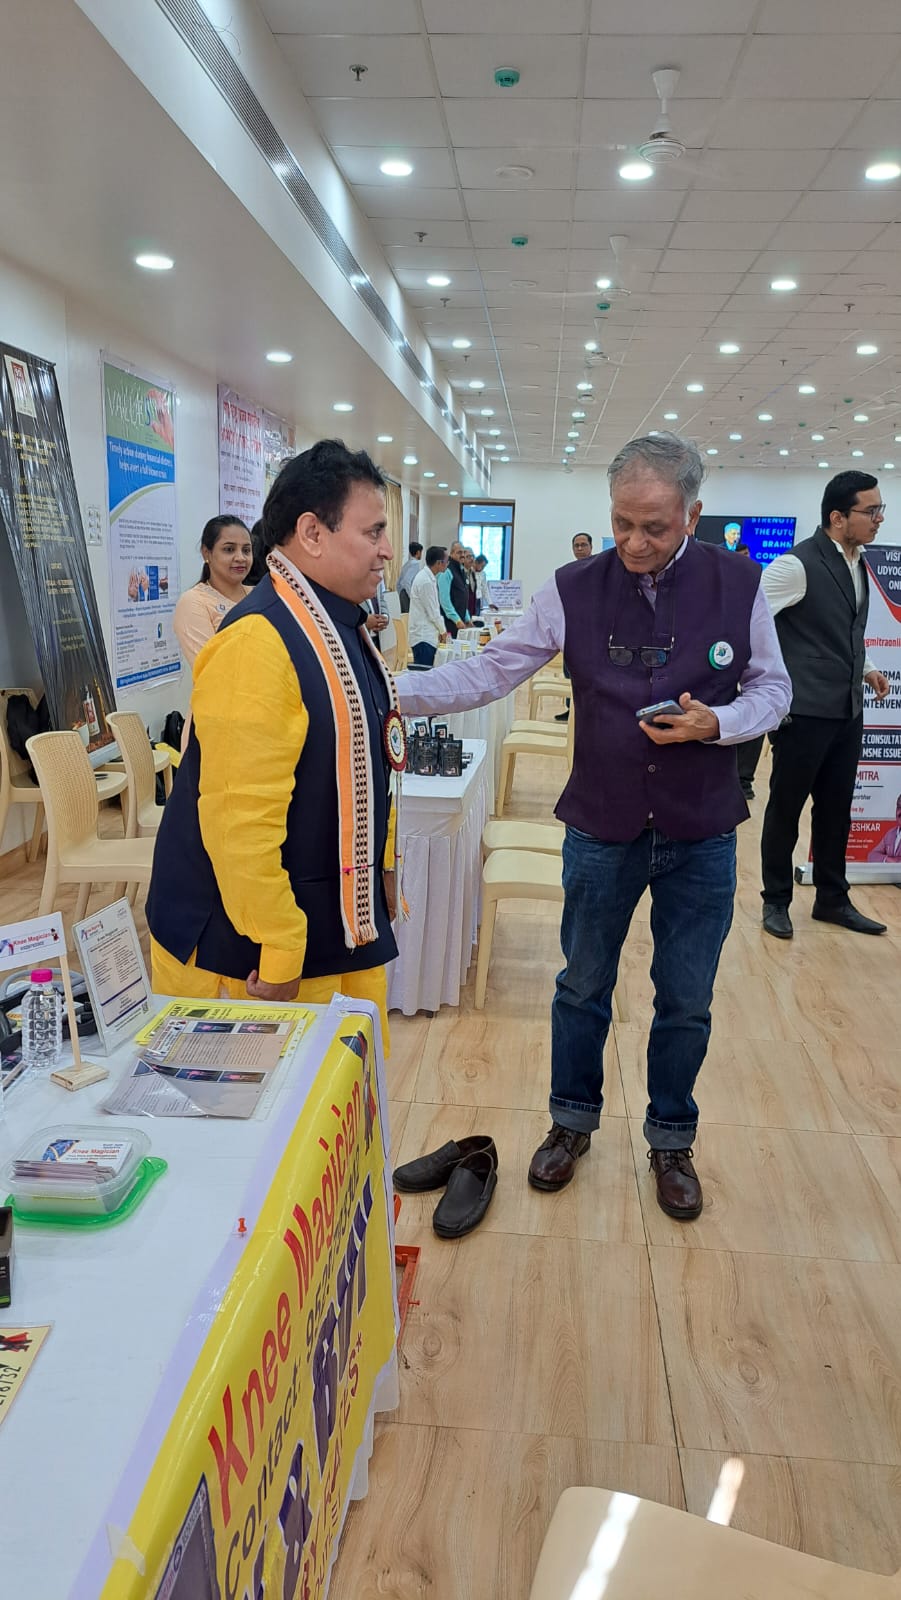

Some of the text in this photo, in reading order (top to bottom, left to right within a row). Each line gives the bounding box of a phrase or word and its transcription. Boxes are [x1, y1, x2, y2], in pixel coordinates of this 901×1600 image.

[754, 528, 793, 537] THE FUTU
[755, 552, 781, 560] COM
[885, 551, 901, 561] VISI
[888, 580, 901, 591] ON
[864, 636, 901, 648] gmitraonli
[864, 699, 901, 710] NTERVEN
[863, 747, 882, 758] MSME
[208, 1292, 292, 1528] Knee
[283, 1080, 362, 1310] Magician
